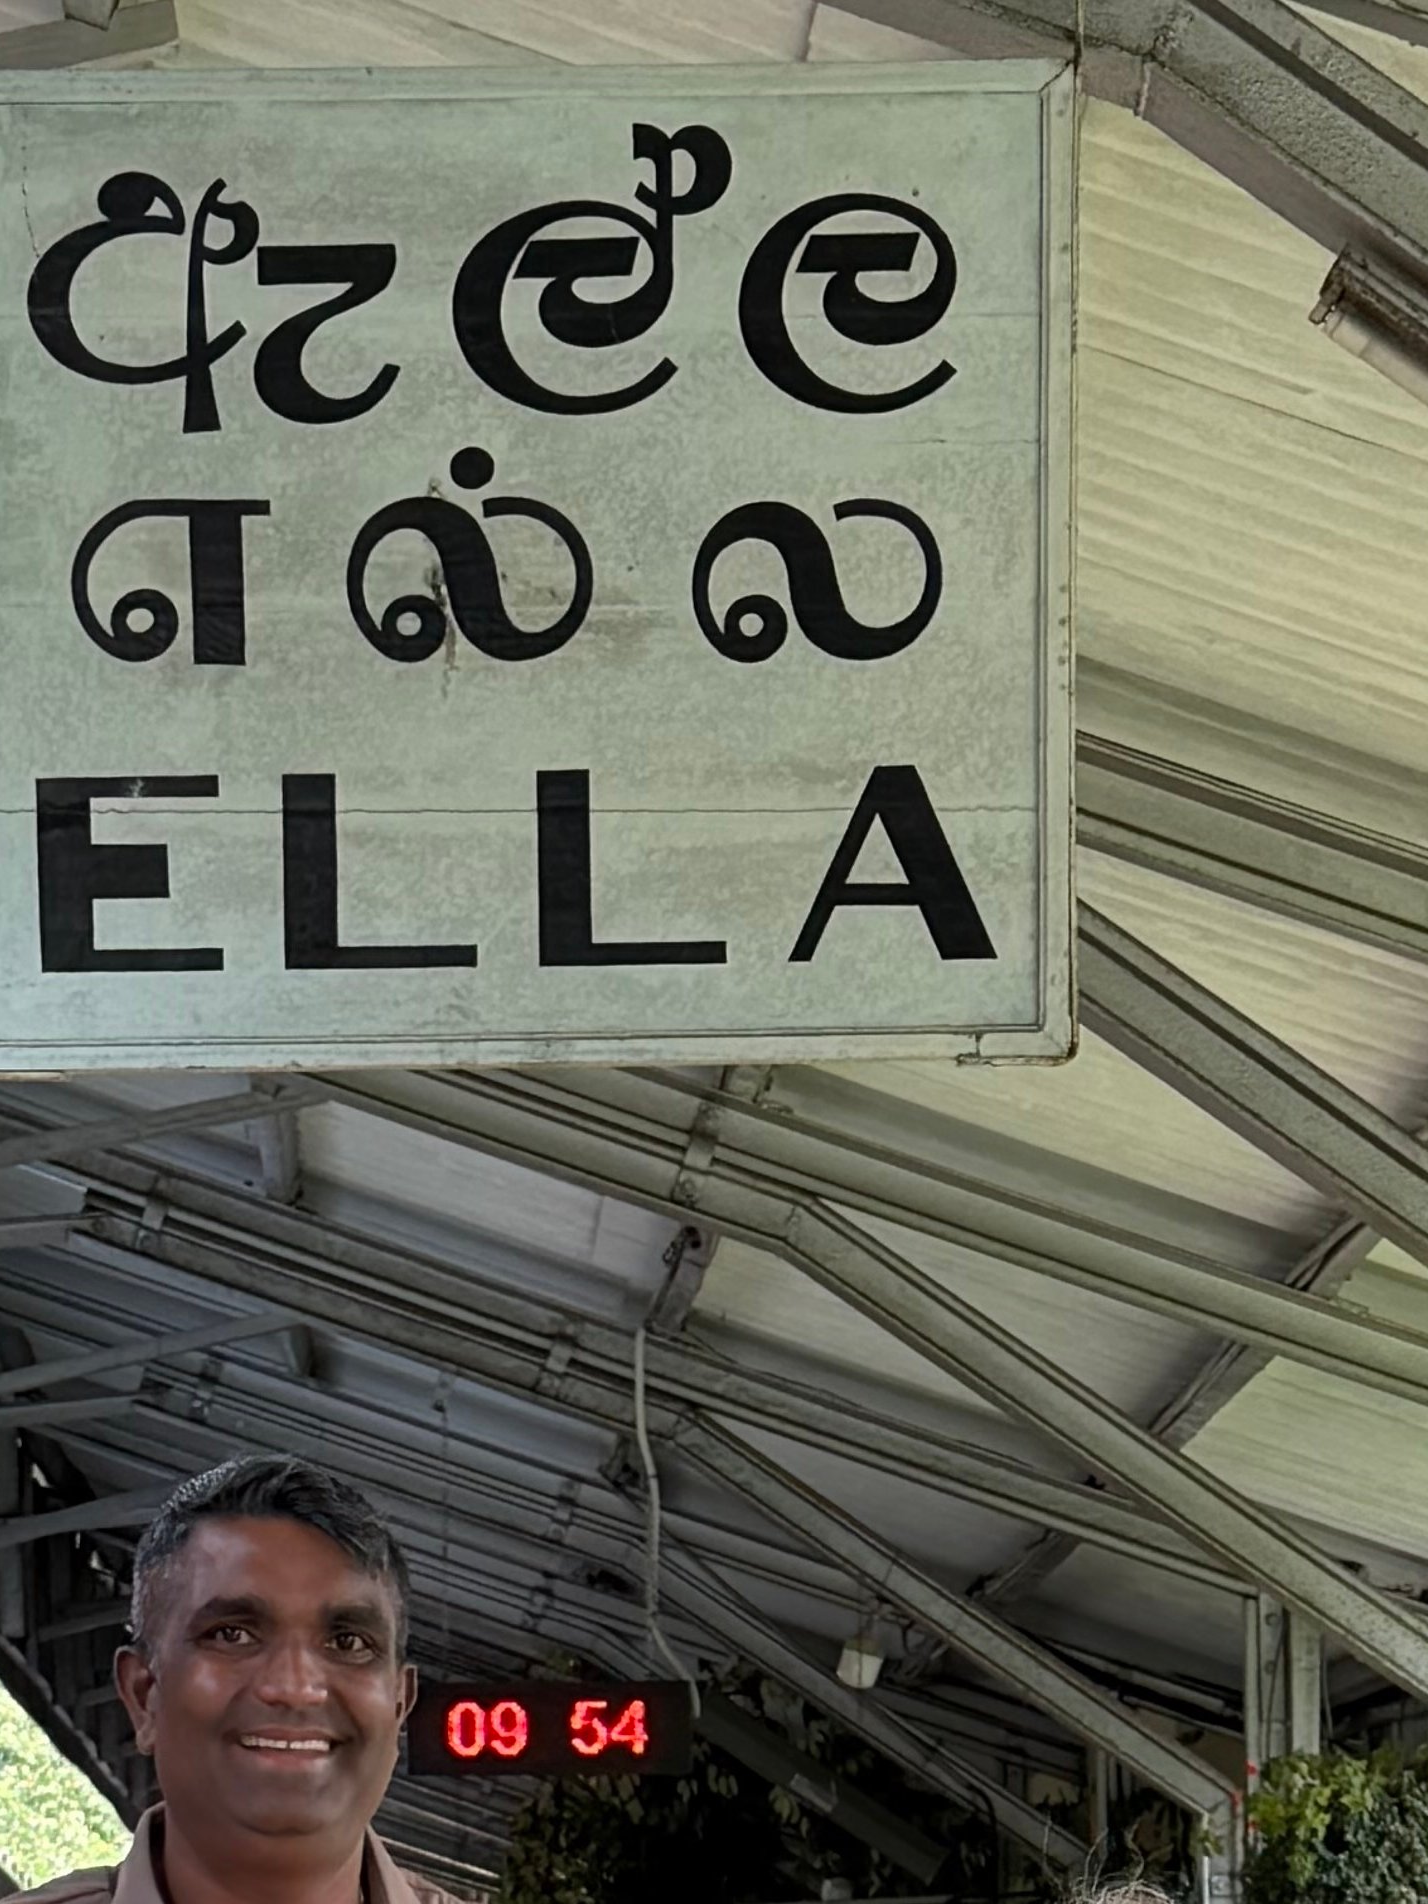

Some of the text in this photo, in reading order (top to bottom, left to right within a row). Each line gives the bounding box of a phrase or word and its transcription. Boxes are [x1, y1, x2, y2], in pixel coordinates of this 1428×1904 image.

[27, 122, 958, 433] ඇල්ල
[70, 446, 943, 666] எல்ல
[35, 764, 998, 973] ELLA
[447, 1700, 649, 1757] 09 54
